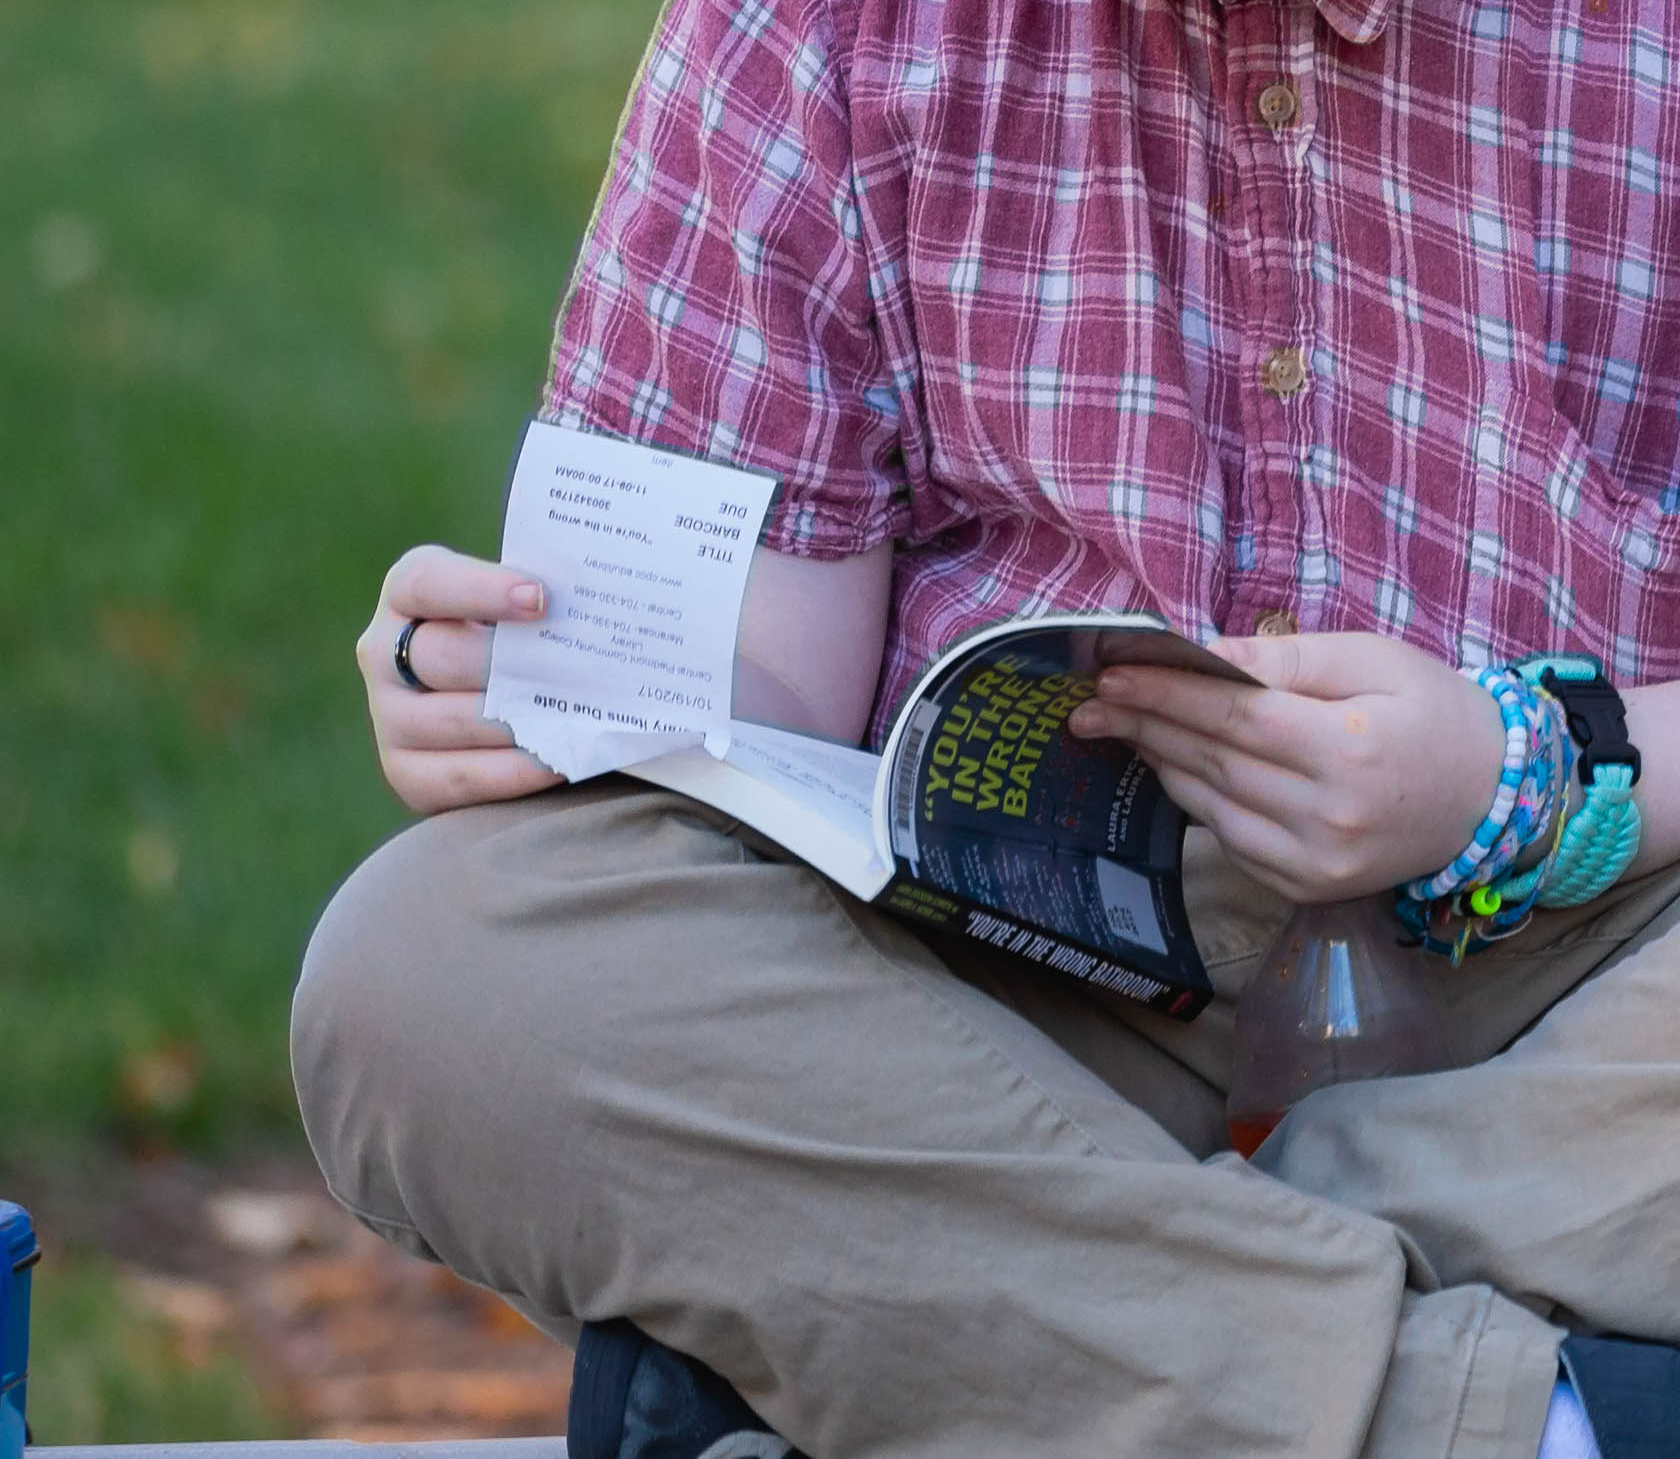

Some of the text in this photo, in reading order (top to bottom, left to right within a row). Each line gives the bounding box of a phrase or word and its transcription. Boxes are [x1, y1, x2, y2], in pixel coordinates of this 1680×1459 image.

[548, 509, 581, 527] wrong
[719, 501, 748, 519] DUE
[583, 518, 601, 532] the
[603, 523, 612, 534] in
[674, 513, 741, 541] BARCODE
[698, 544, 734, 563] TITLE
[648, 605, 682, 621] Central
[610, 635, 643, 653] Library
[538, 629, 712, 683] Central Piedmont Community College
[533, 693, 568, 713] Date
[638, 685, 713, 711] 10/19/2017
[573, 702, 601, 721] Due
[952, 674, 1034, 804] IN THE
[976, 673, 1075, 811] WRONG
[1124, 766, 1147, 815] LAURA
[1106, 801, 1121, 852] LAURA
[1009, 930, 1026, 953] IN
[1024, 934, 1051, 961] THE
[1046, 941, 1098, 978] WRONG
